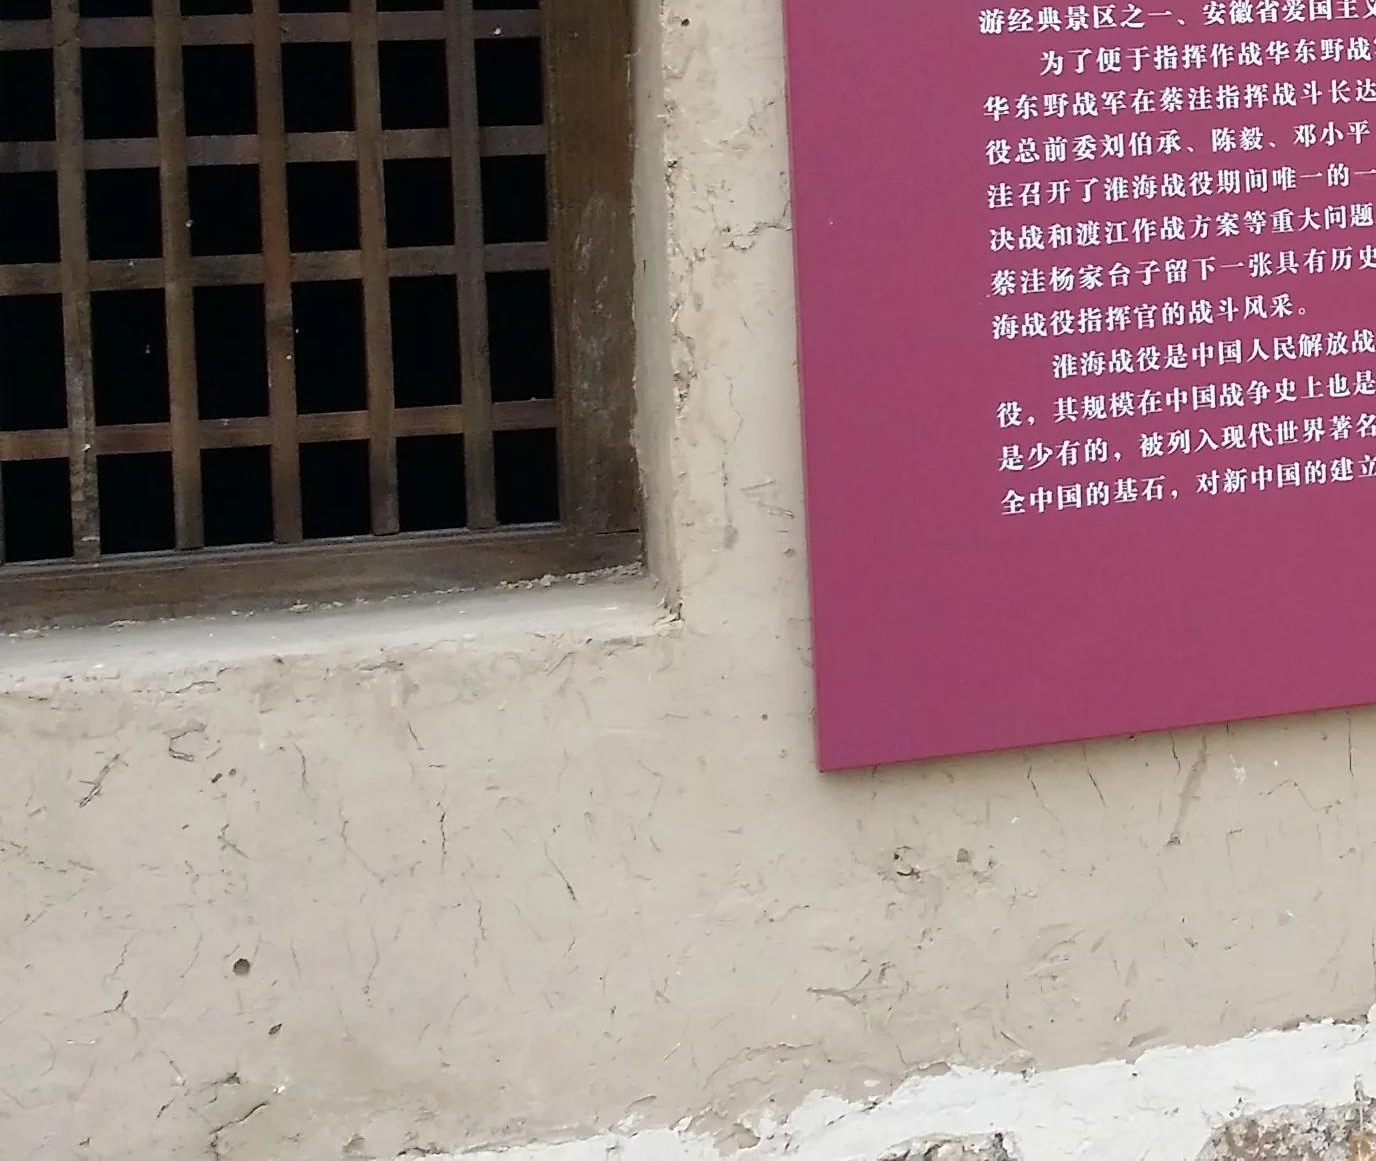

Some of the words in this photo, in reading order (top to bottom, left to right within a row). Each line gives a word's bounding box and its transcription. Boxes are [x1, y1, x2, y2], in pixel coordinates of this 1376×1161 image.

[992, 293, 1308, 341] 海战役指挥官的战斗风采。
